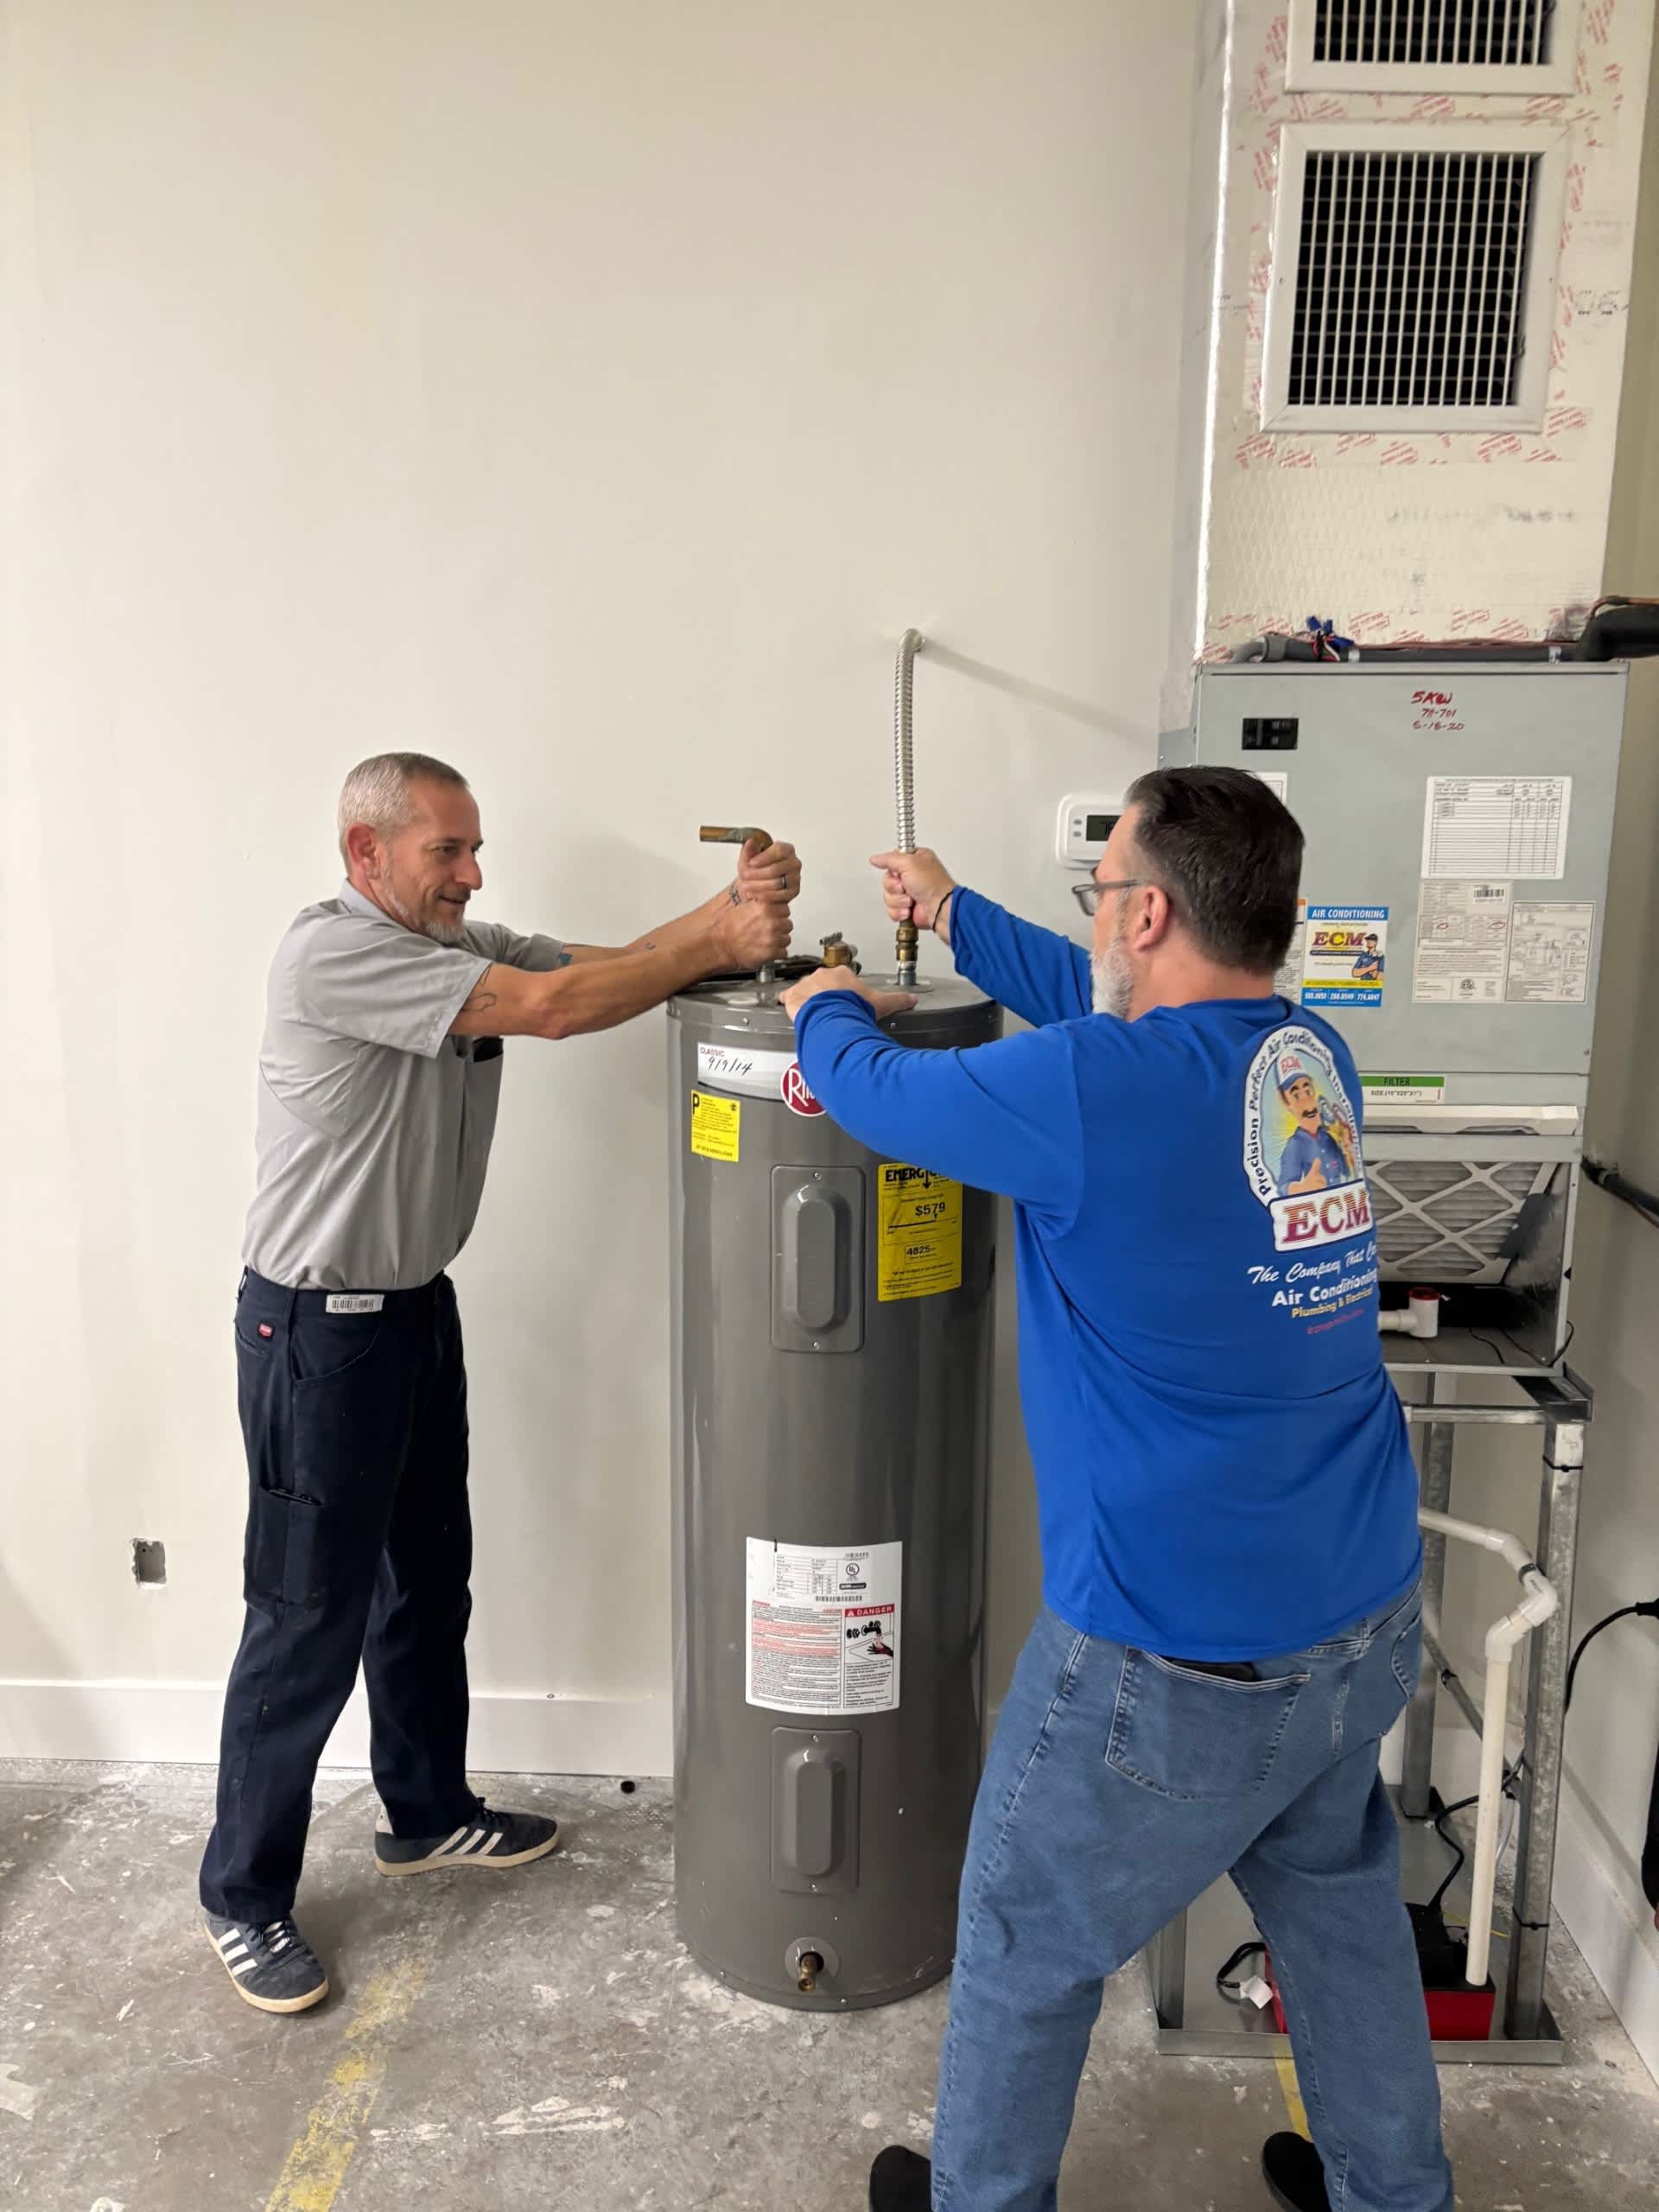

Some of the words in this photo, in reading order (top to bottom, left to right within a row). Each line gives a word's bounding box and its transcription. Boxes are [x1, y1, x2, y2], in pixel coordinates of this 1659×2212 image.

[1312, 909, 1325, 918] AIR
[1328, 909, 1384, 918] CONDITIONING
[1312, 931, 1367, 946] ECM
[700, 1047, 725, 1057] CLASSIC
[1268, 1039, 1281, 1058] Air
[1249, 1056, 1268, 1111] Perfect
[1383, 1077, 1410, 1086] FILTER
[1247, 1118, 1272, 1197] Precision
[915, 1202, 945, 1217] $579
[1282, 1188, 1370, 1243] ECM
[1247, 1265, 1279, 1285] The
[1286, 1260, 1341, 1282] Company
[1272, 1289, 1303, 1306] Air
[1309, 1268, 1377, 1302] Conditioning
[1292, 1301, 1337, 1319] Plumbing
[857, 1606, 892, 1616] DANGER
